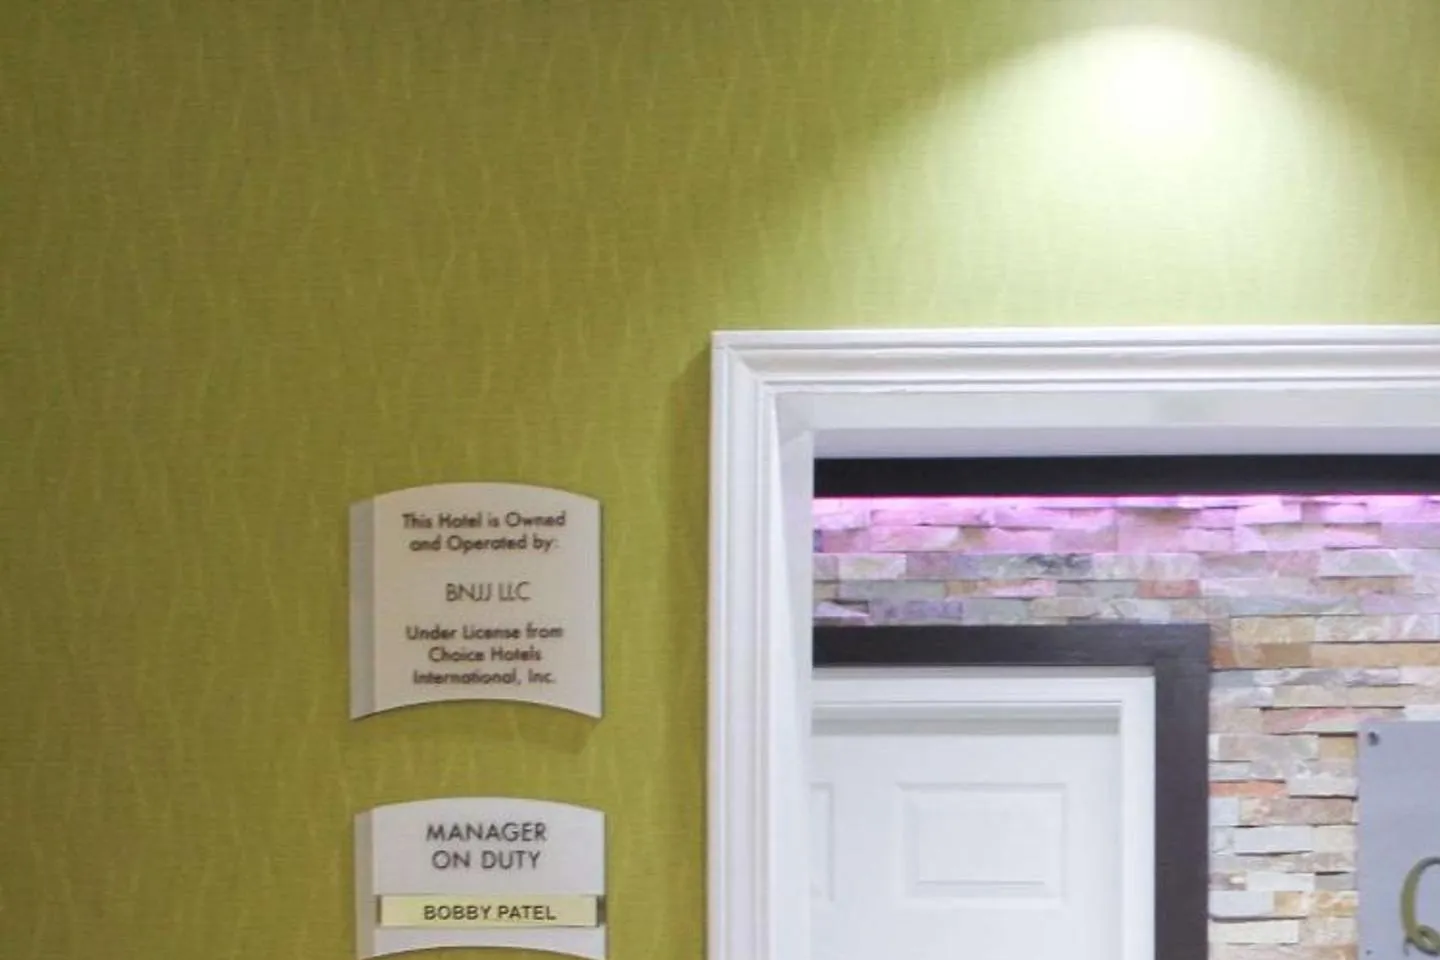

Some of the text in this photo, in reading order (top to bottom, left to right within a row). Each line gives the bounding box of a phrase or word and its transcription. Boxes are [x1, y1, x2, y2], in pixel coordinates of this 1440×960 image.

[402, 511, 566, 529] This Hotel is Owned
[409, 535, 441, 551] and
[447, 535, 527, 554] Operated
[446, 581, 532, 602] BNJJ LLC
[406, 623, 563, 641] Under License from
[428, 646, 542, 662] Choice Hotels
[528, 669, 556, 683] Inc.
[426, 822, 548, 842] MANAGER
[431, 850, 541, 870] ON DUTY
[424, 905, 557, 921] BOBBY PATEL
